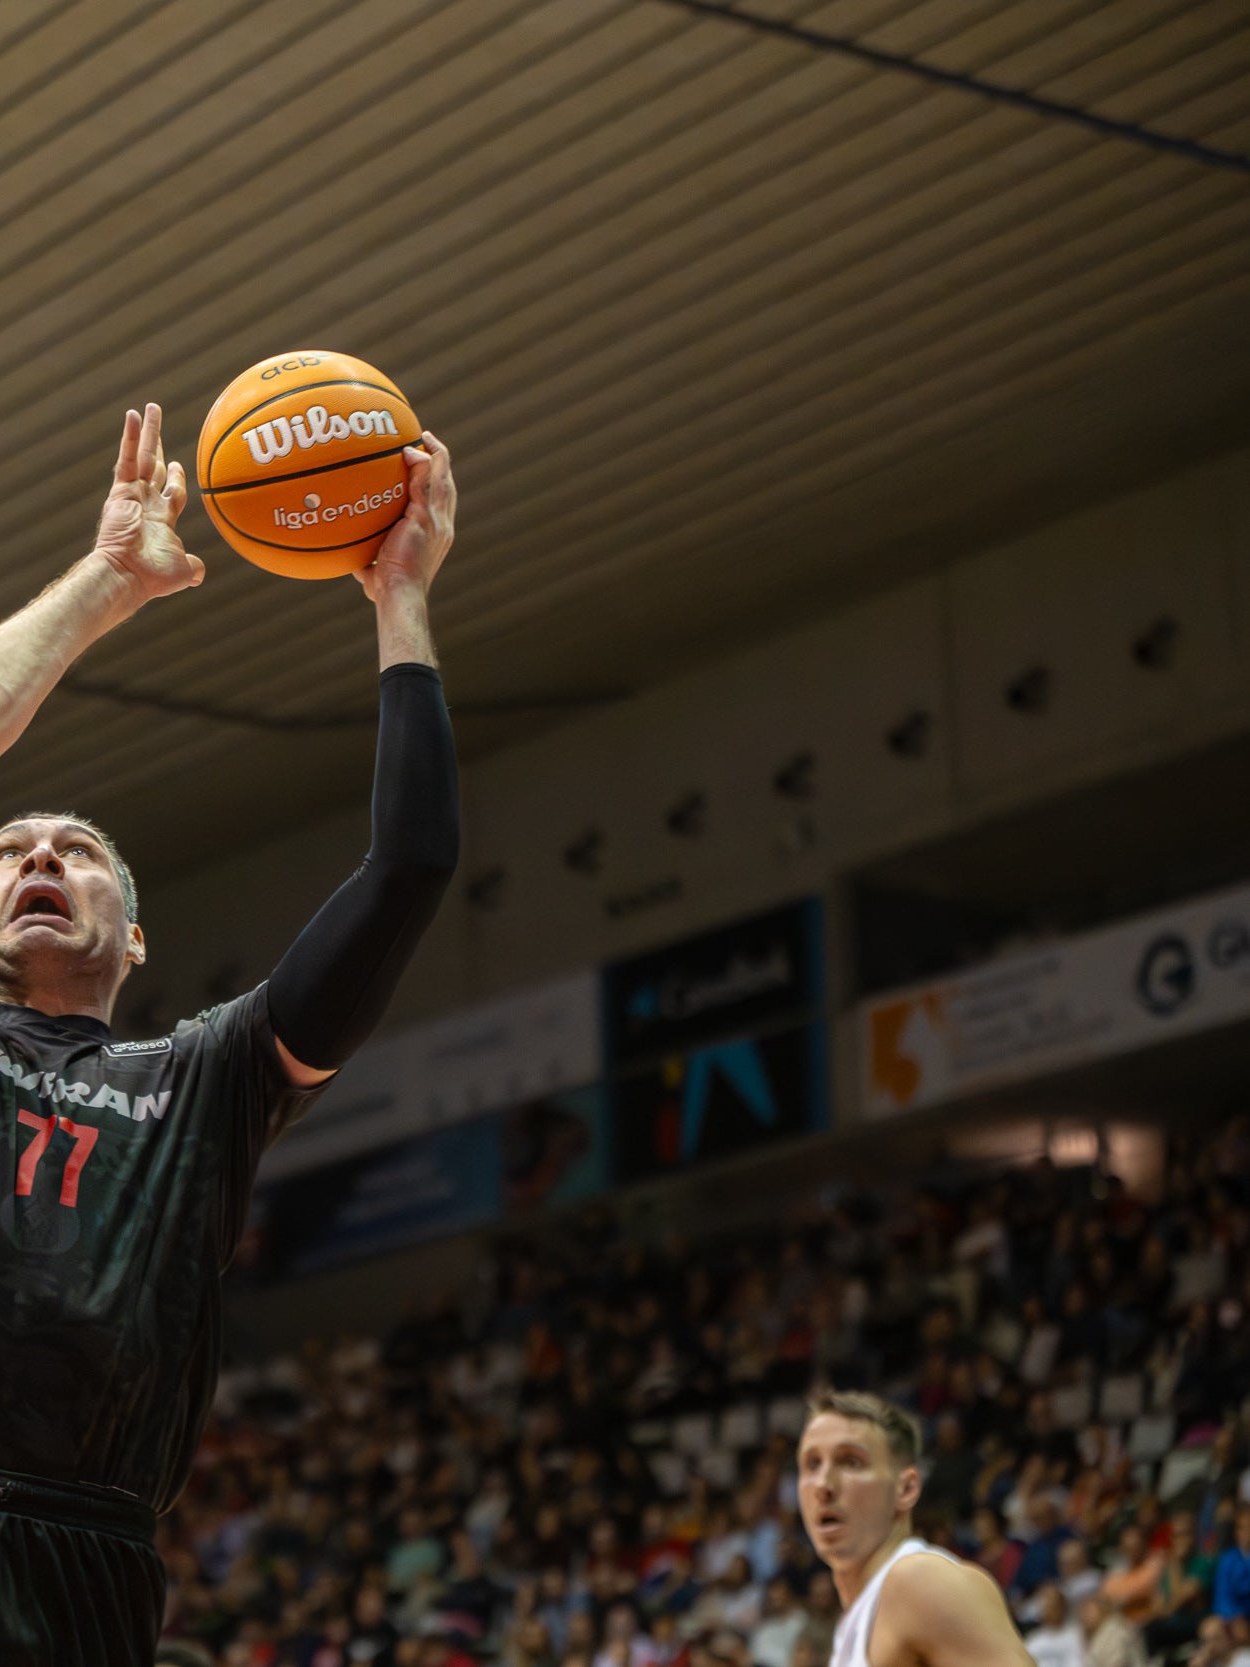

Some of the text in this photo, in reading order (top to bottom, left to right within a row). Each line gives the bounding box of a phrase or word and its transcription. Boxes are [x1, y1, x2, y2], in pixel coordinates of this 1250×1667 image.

[261, 357, 321, 380] acb
[242, 405, 399, 465] Wilson
[273, 481, 405, 529] liga endesa
[15, 1108, 100, 1208] 77
